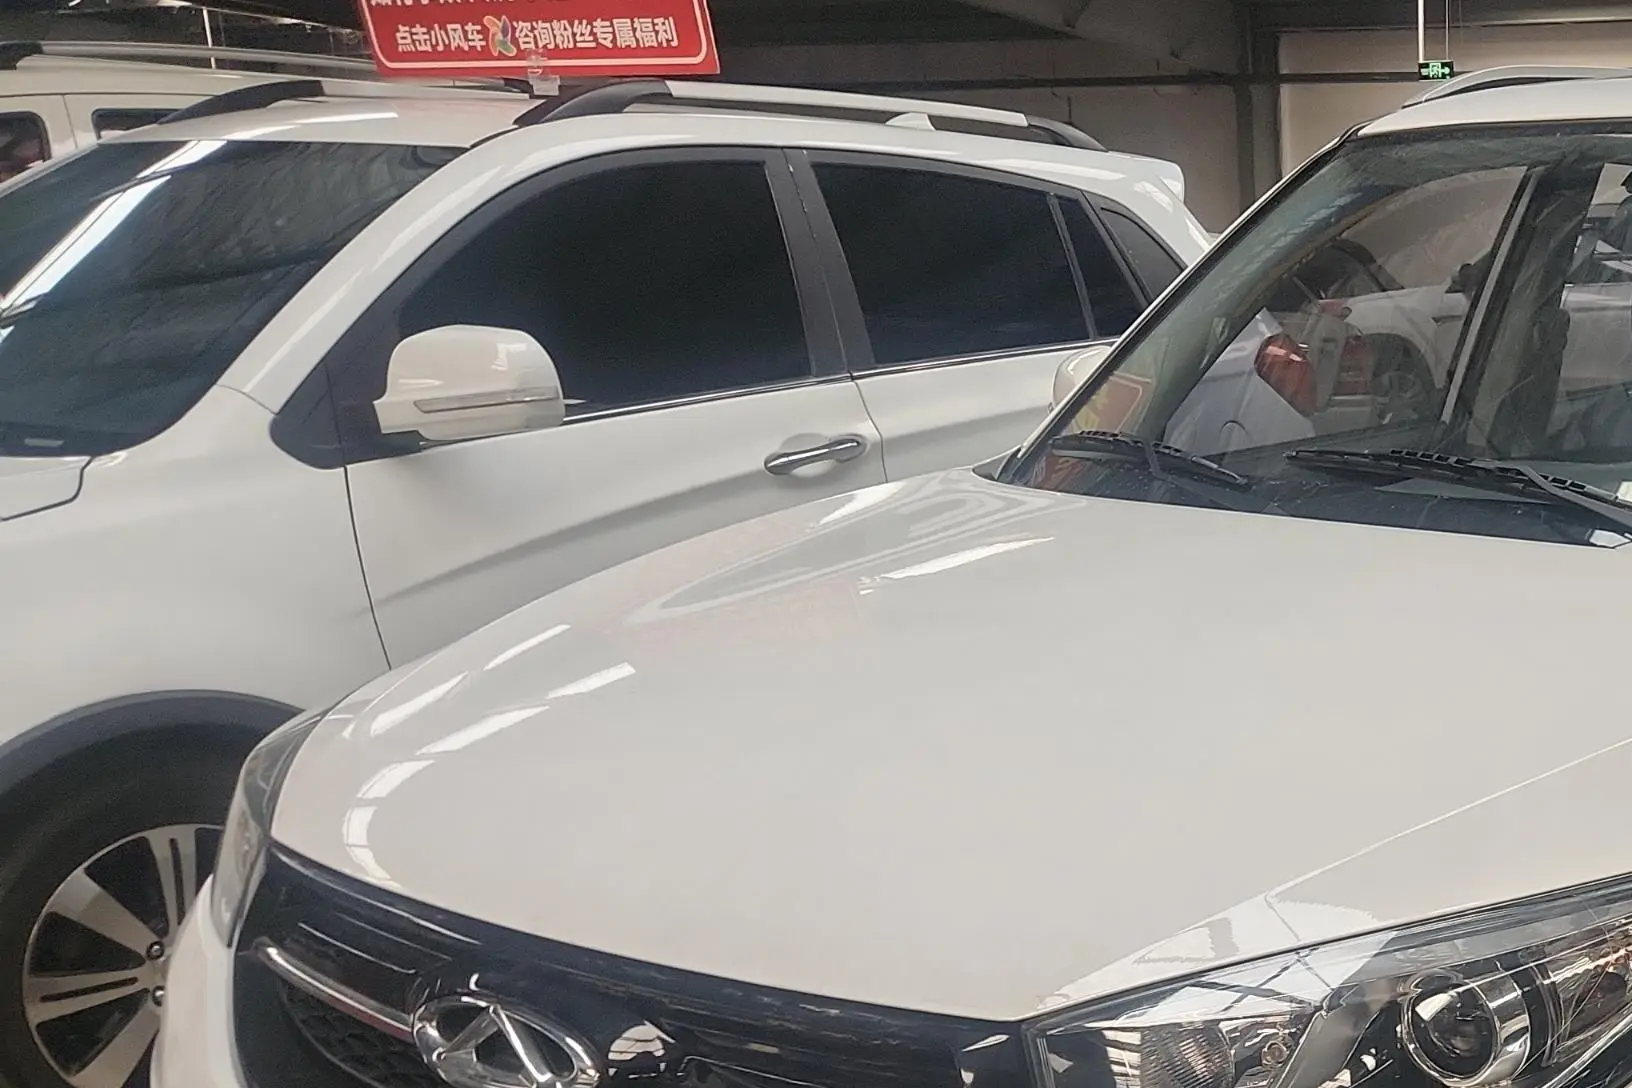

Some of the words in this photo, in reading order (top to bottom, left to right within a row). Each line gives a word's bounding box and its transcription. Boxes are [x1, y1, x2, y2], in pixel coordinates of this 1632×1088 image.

[395, 22, 486, 53] 点击小风车
[512, 17, 679, 51] 咨询粉丝专属福利
